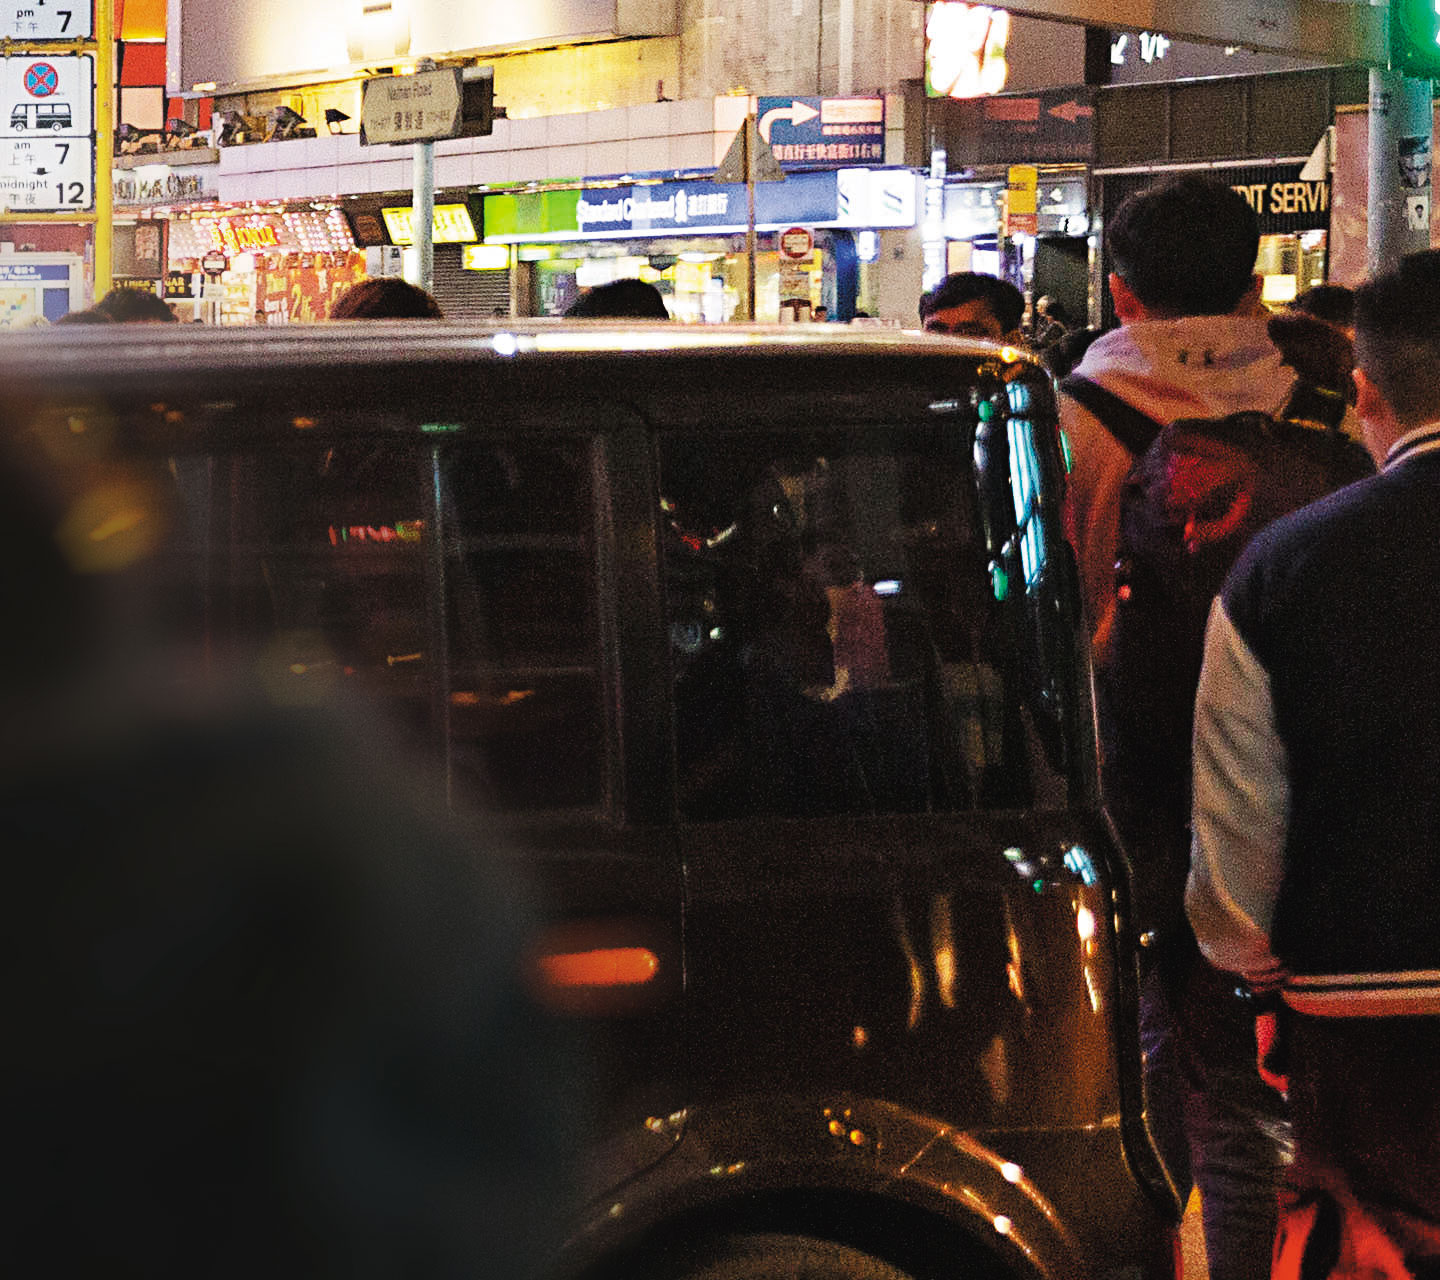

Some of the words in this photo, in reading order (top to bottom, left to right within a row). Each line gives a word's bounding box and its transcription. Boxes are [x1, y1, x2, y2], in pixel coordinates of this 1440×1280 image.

[16, 9, 34, 20] pm
[56, 11, 72, 33] 7
[13, 142, 31, 150] am
[54, 143, 70, 165] 7
[56, 181, 85, 205] 12
